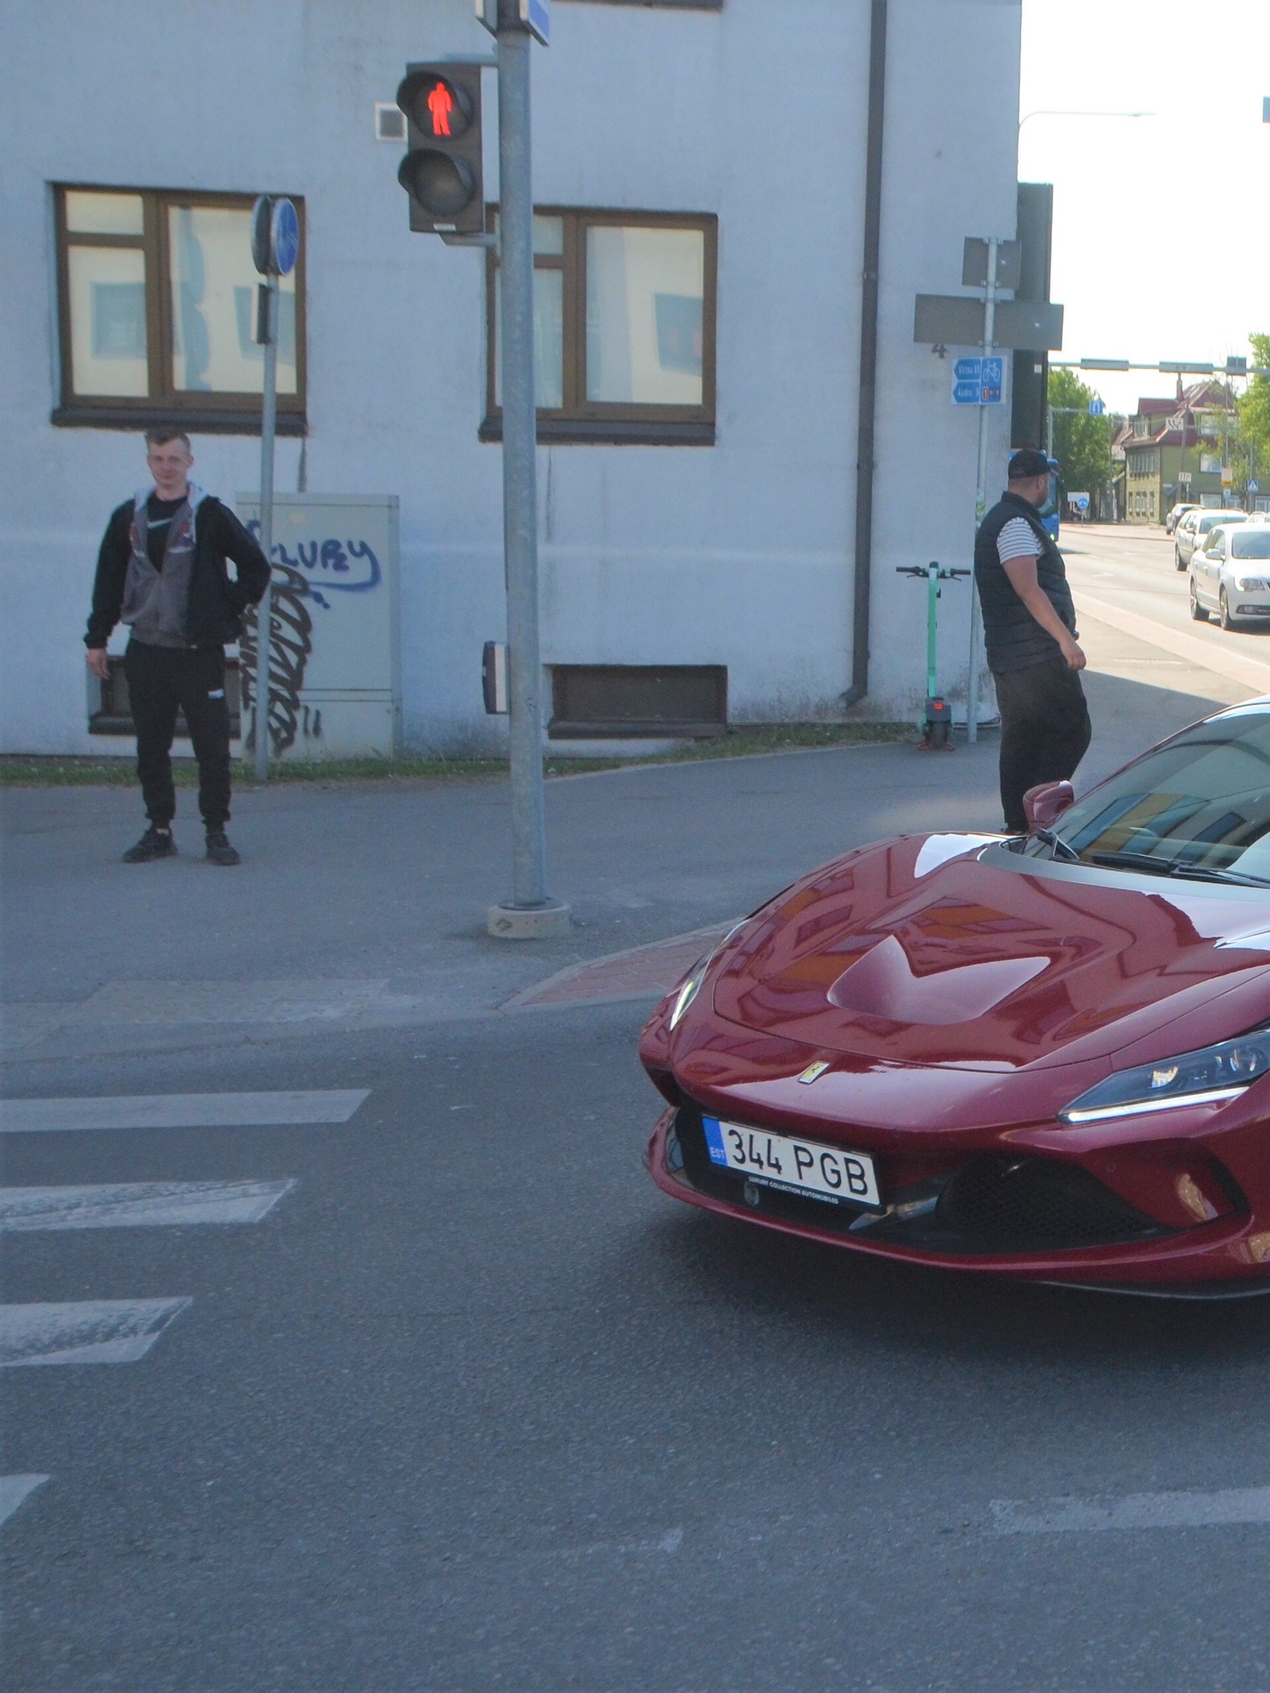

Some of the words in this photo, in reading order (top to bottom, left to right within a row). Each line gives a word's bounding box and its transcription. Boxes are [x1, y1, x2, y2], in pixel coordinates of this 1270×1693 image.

[709, 1146, 726, 1160] EST
[728, 1129, 783, 1175] 344
[793, 1145, 869, 1196] PGB
